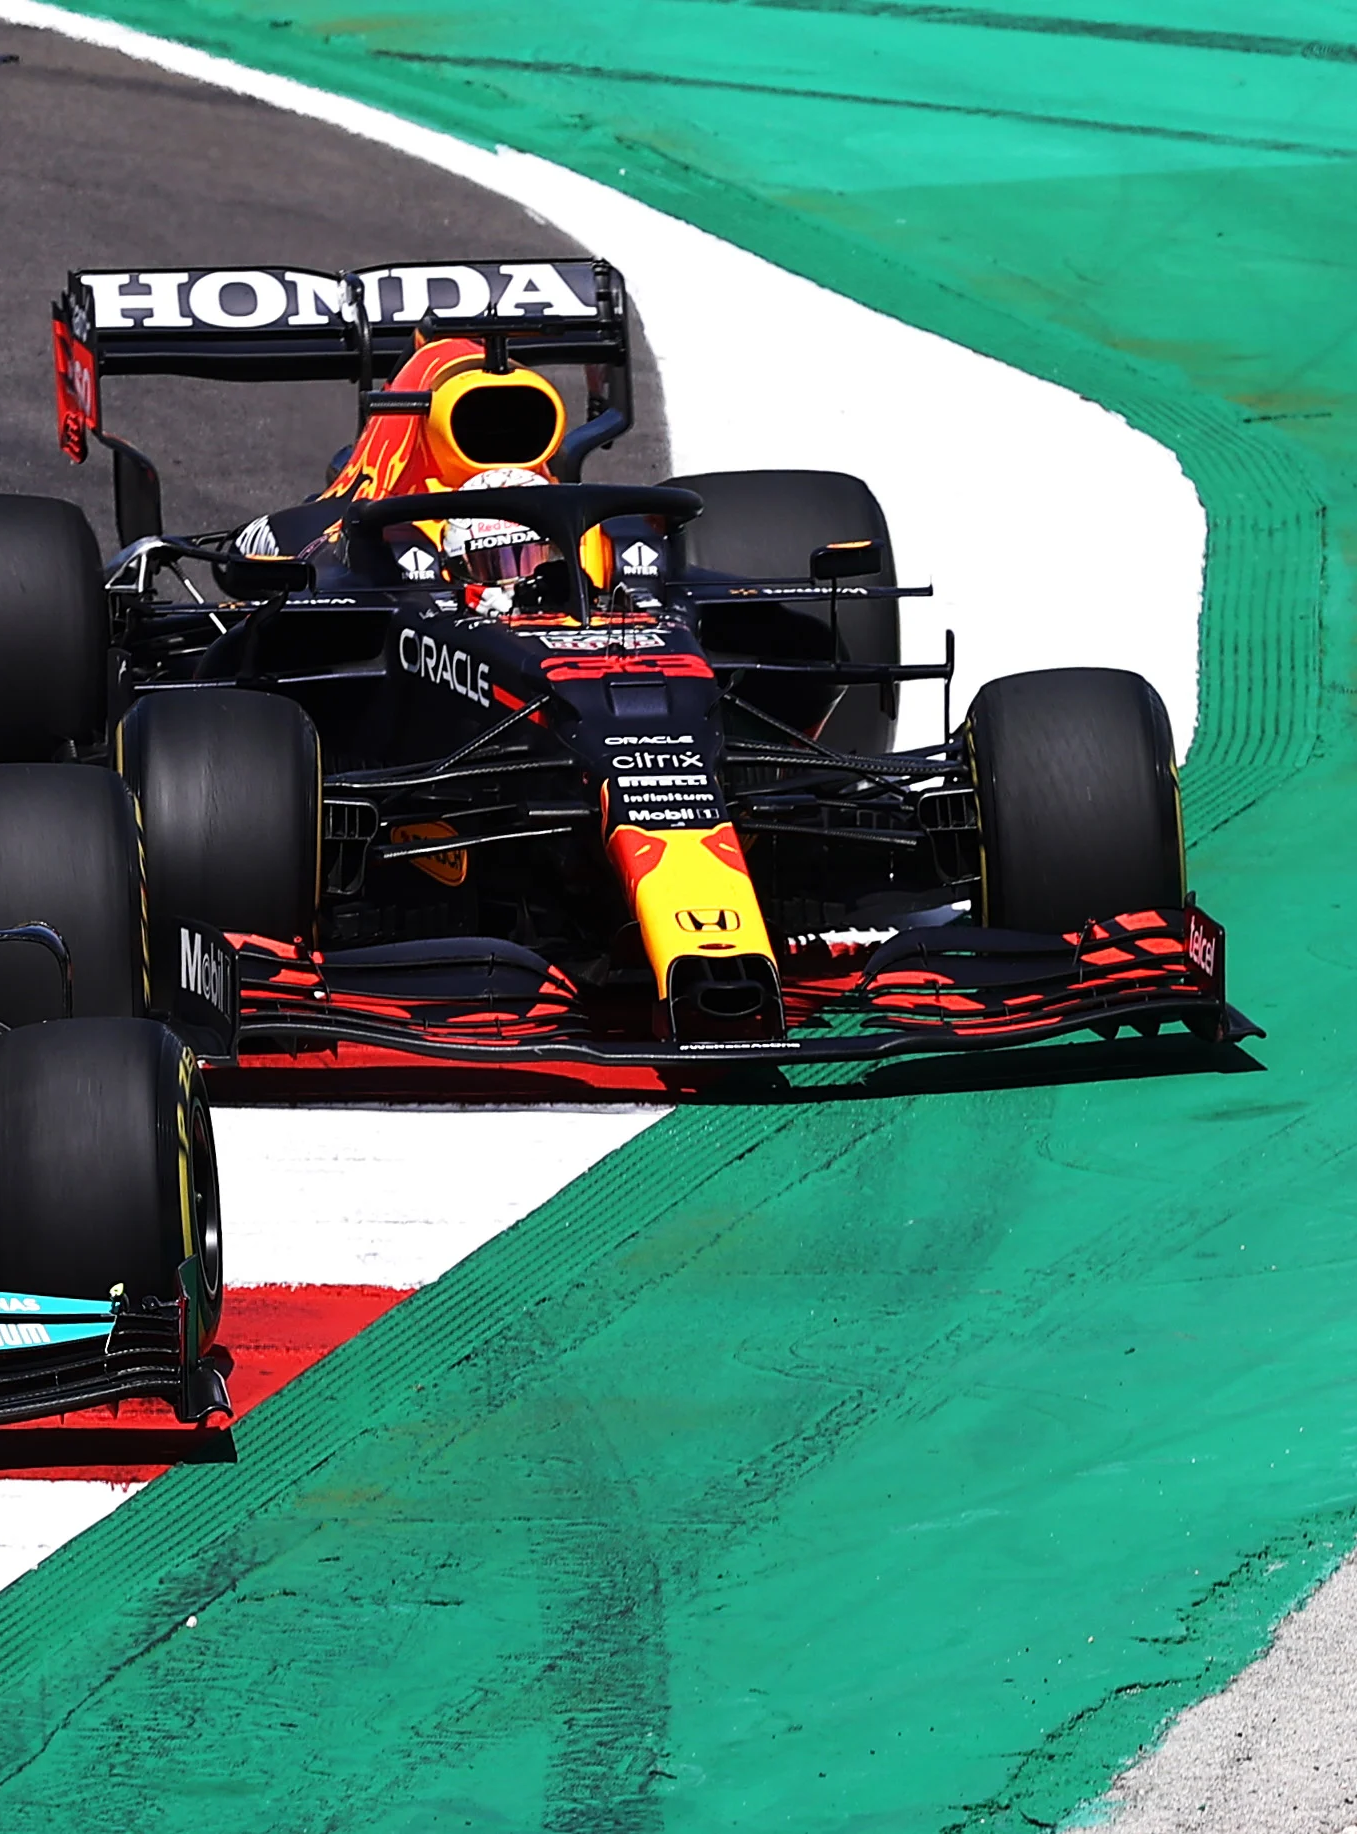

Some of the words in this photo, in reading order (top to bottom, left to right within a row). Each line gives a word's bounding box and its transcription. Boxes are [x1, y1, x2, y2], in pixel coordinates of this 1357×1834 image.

[81, 264, 597, 328] HONDA
[470, 530, 541, 551] HONDA
[399, 628, 490, 707] ORACLE
[605, 735, 694, 745] ORACLE
[612, 752, 703, 768] citrix
[617, 775, 708, 787] PIRELLI
[628, 808, 694, 821] Mobil
[1189, 915, 1215, 976] telcel
[181, 927, 223, 1012] Mobil
